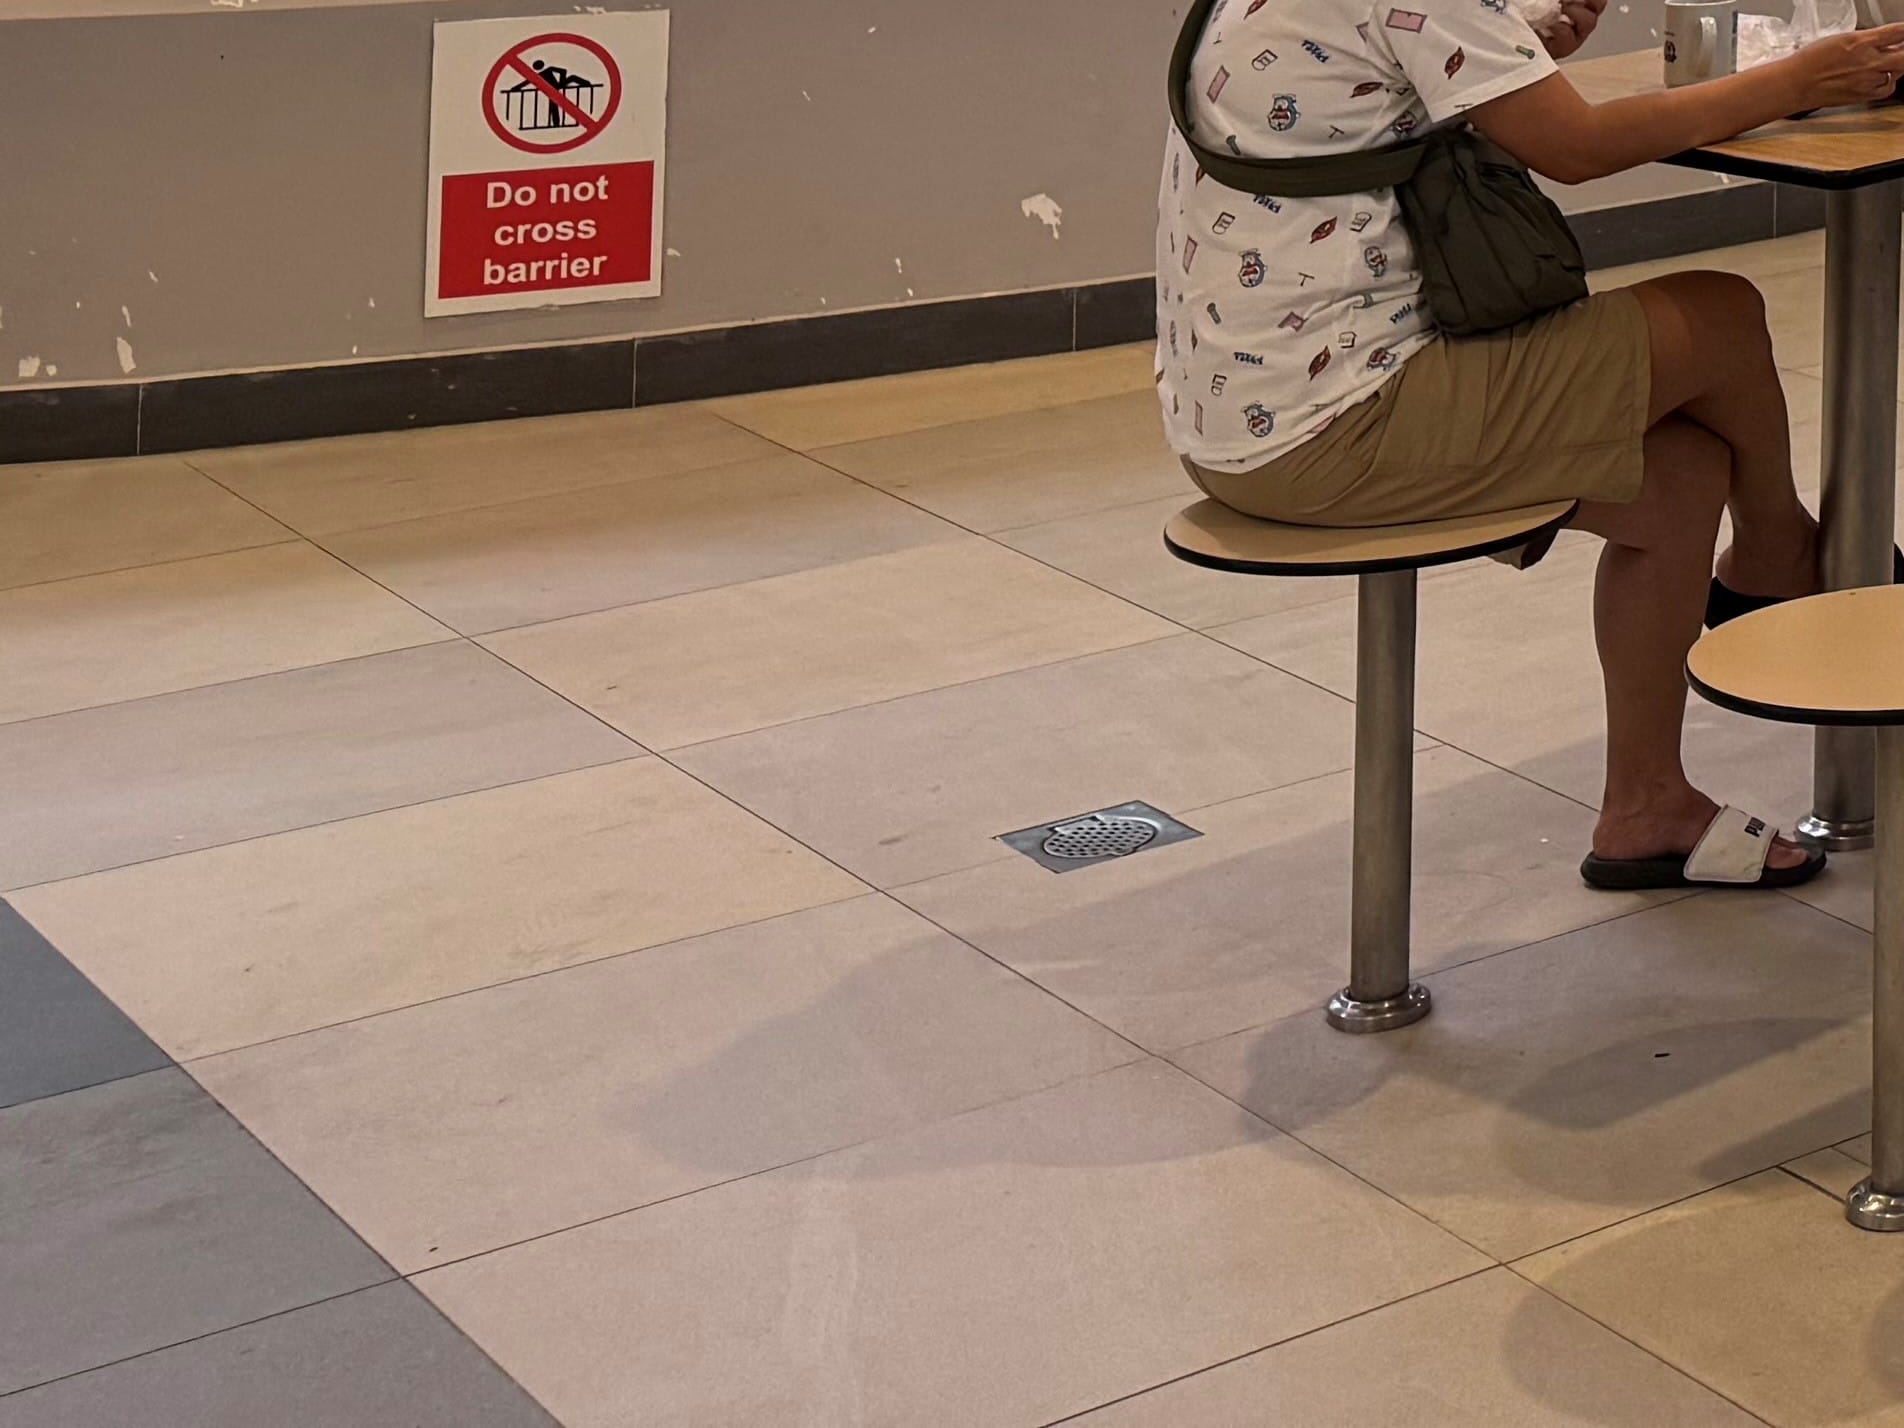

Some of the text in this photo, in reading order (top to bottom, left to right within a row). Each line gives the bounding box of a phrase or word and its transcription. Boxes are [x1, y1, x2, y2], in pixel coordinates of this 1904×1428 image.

[486, 174, 609, 209] Do not
[494, 217, 597, 246] cross
[483, 252, 608, 285] barrier
